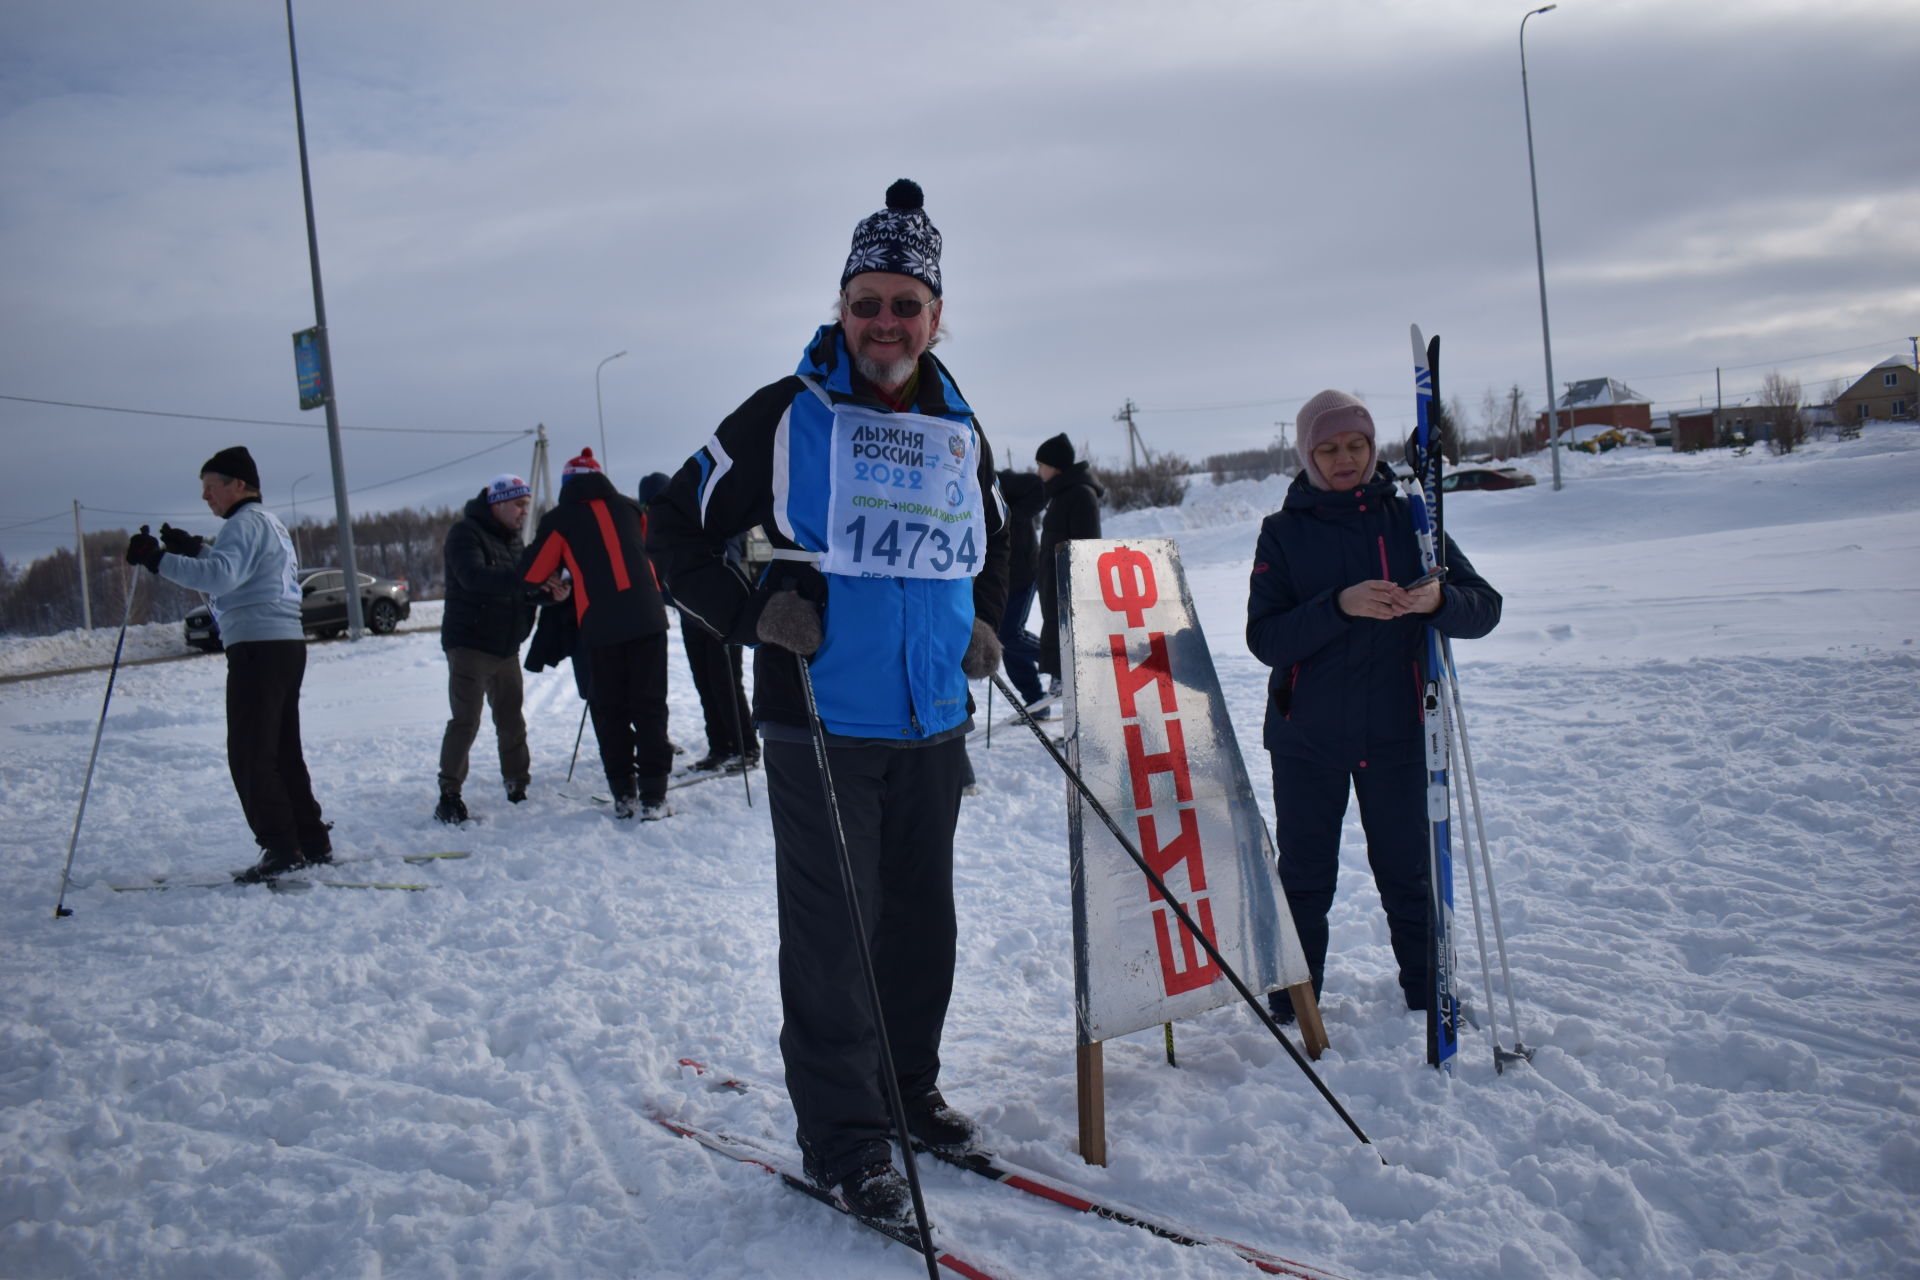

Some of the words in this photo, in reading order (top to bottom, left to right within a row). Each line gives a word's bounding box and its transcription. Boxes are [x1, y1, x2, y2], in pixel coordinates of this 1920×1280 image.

[851, 425, 924, 450] ЛЫЖНЯ
[853, 443, 924, 468] РОССИИ
[854, 461, 923, 490] 2022
[852, 495, 889, 510] СПОРТ
[899, 502, 939, 518] НОРМА
[938, 510, 972, 524] ЖИЗНИ
[846, 515, 978, 573] 14734
[1097, 546, 1223, 997] ФИНИШ
[1437, 936, 1447, 995] CLASSIC
[1440, 997, 1452, 1027] XC
